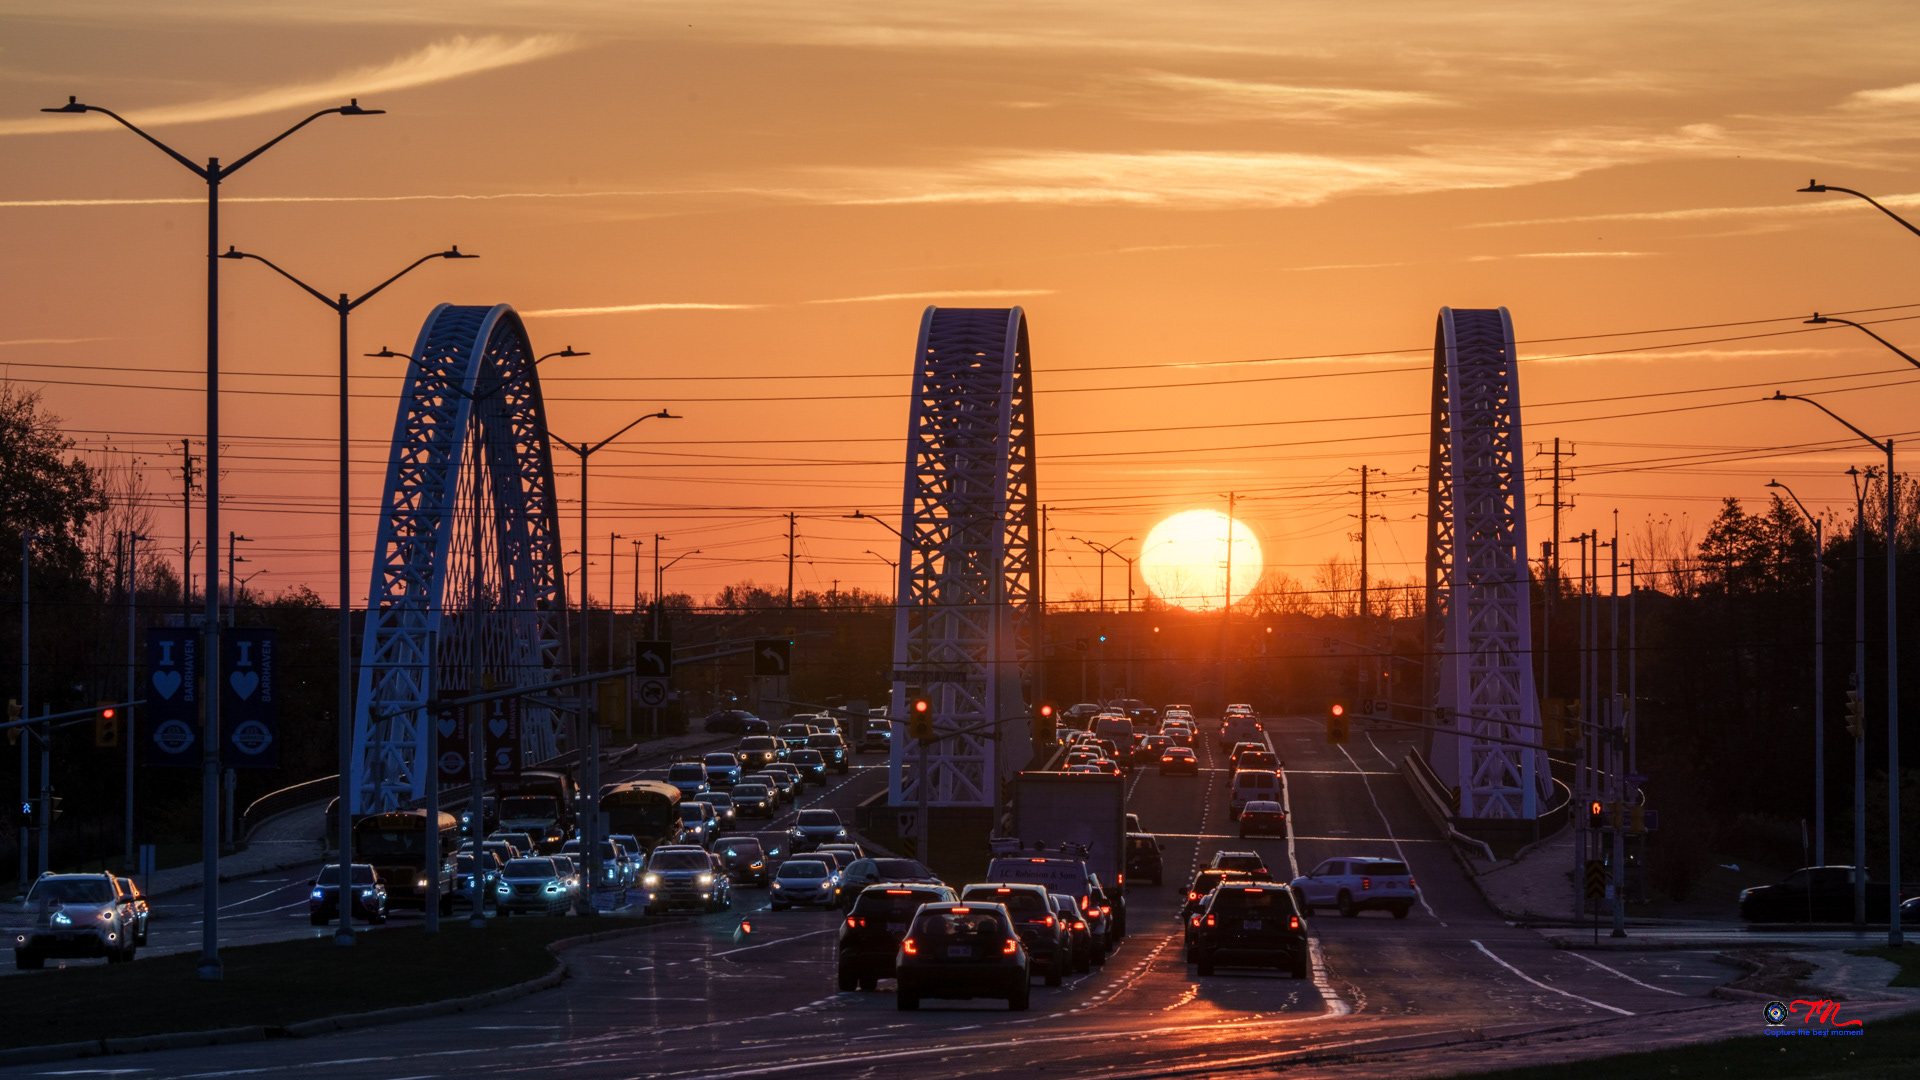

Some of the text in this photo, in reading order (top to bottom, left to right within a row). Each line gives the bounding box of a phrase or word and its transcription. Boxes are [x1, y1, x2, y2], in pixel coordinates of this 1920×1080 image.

[159, 640, 175, 666] I
[236, 640, 252, 667] I
[184, 639, 194, 702] BARRHAVEN
[261, 640, 272, 703] BARRHAVEN
[1015, 869, 1048, 878] Robinson
[1059, 871, 1077, 880] Sons
